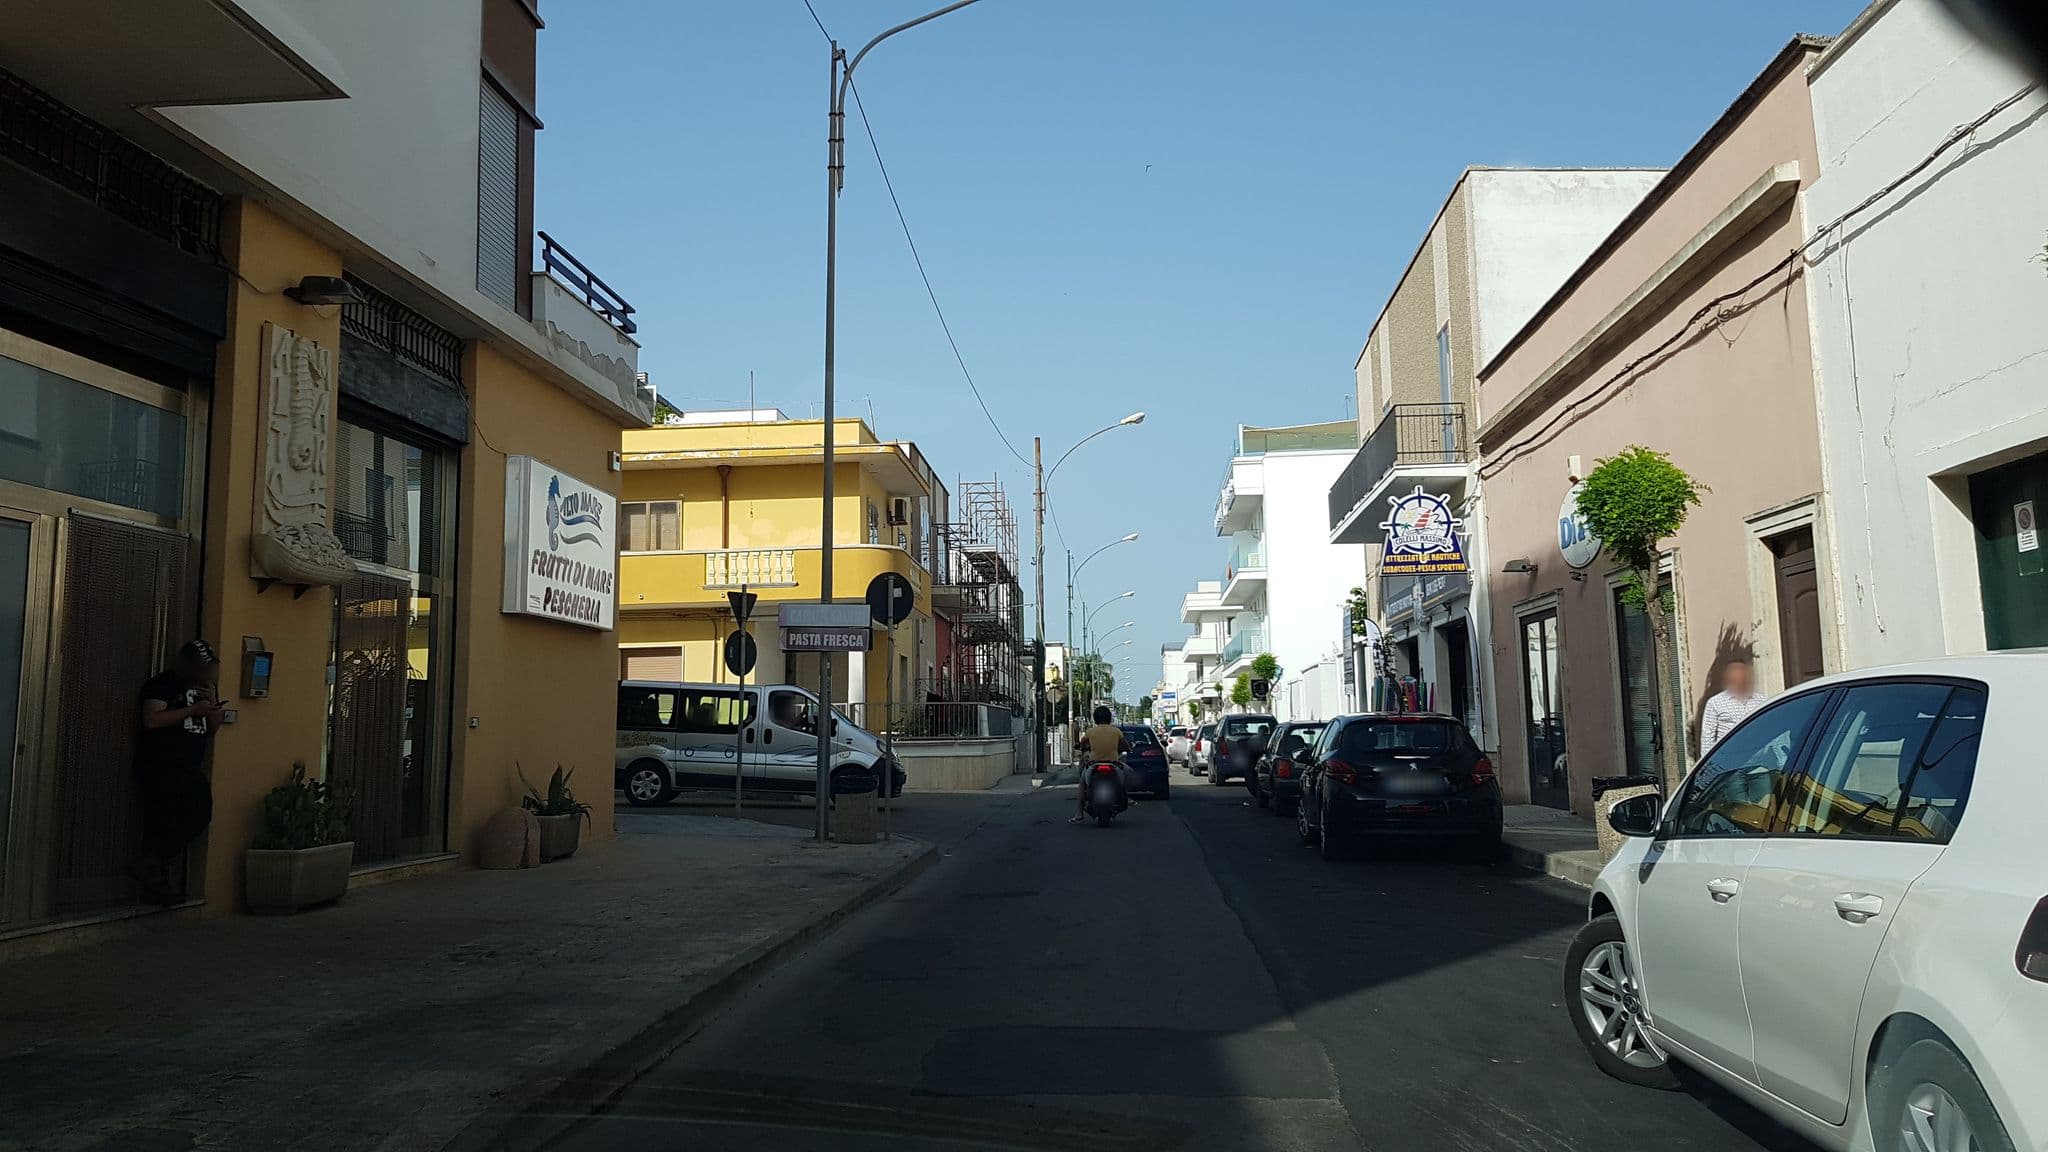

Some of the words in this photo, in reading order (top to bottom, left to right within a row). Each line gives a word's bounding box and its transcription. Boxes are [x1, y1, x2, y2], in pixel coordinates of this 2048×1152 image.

[560, 492, 579, 517] ALTO
[580, 490, 603, 521] MARE
[1420, 535, 1447, 545] MASSIMO
[531, 549, 573, 583] FRUTTI
[573, 562, 586, 587] DI
[585, 566, 613, 595] MARE
[1437, 563, 1466, 571] SPORTIVA
[543, 586, 601, 623] PESCHERIA
[789, 634, 821, 645] PASTA
[823, 634, 863, 647] FRESCA
